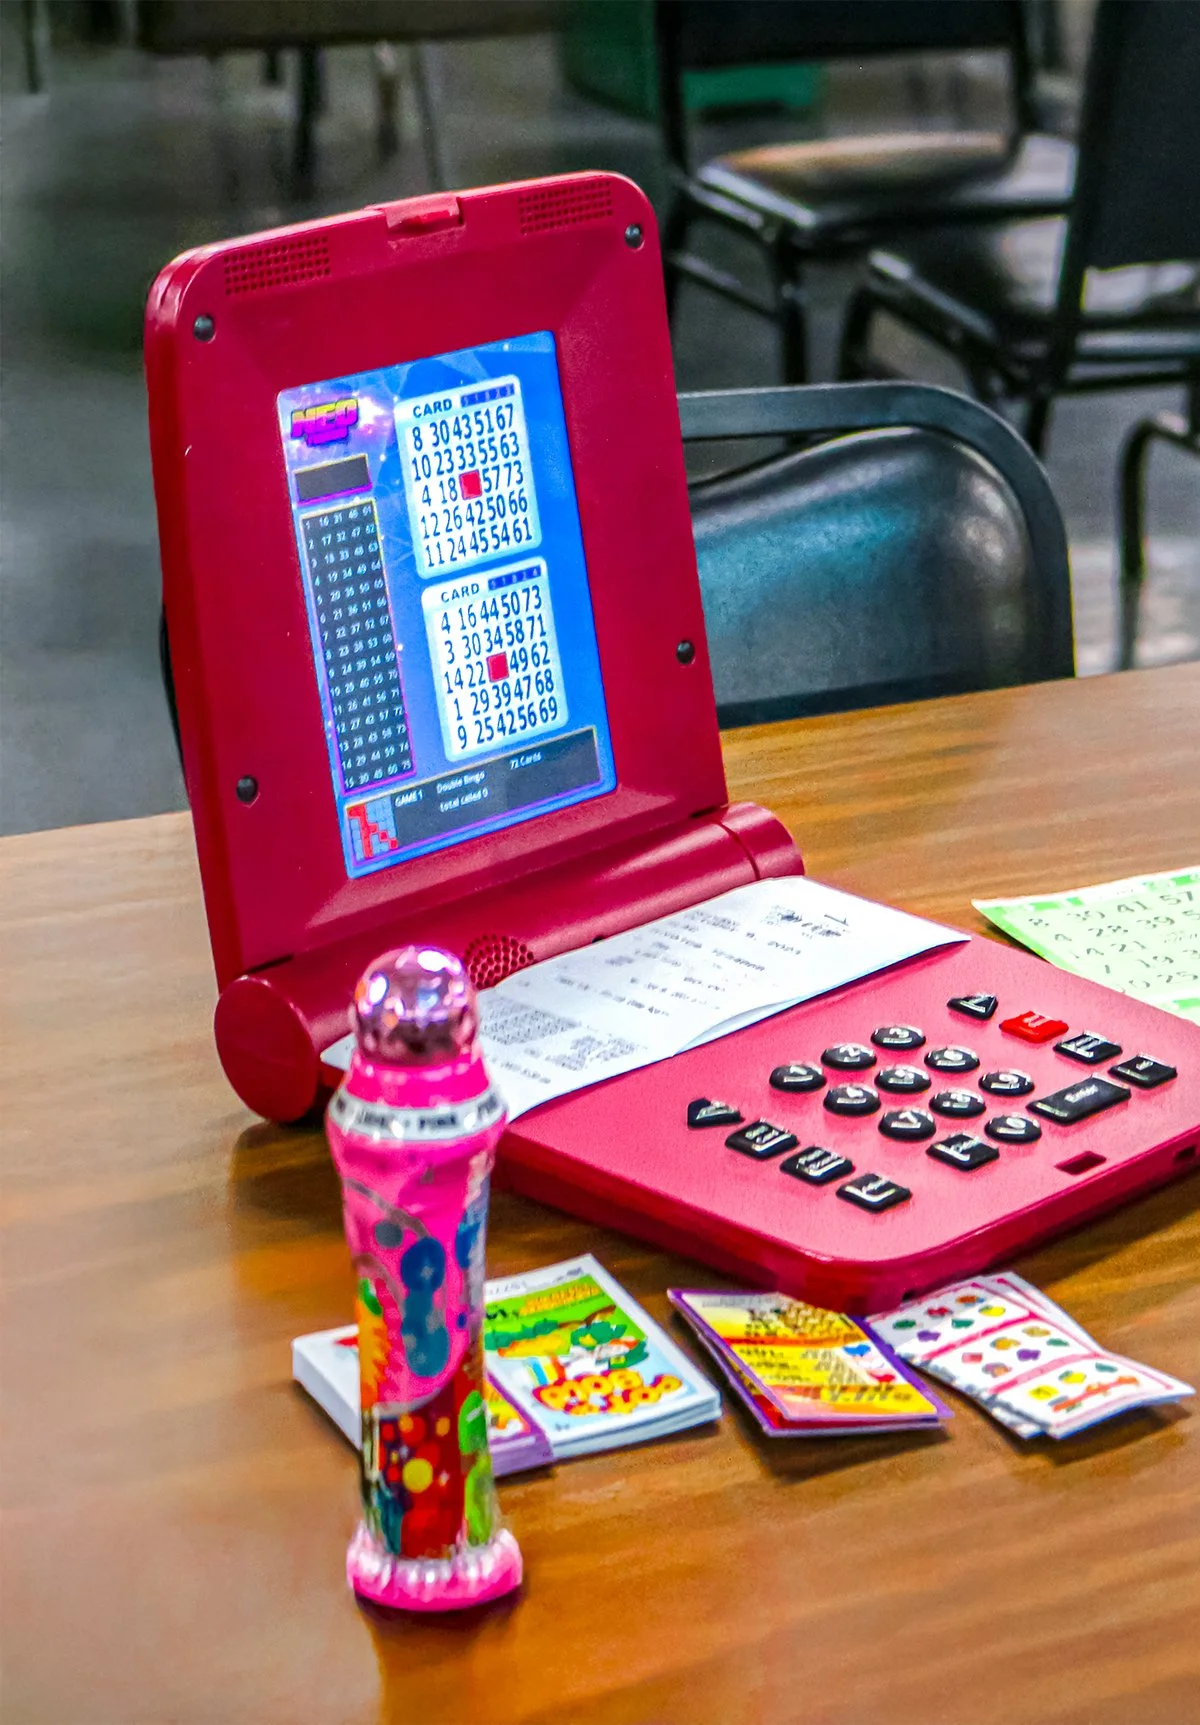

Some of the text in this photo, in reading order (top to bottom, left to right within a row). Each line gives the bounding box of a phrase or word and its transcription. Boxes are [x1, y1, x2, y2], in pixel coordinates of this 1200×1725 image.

[412, 403, 514, 451] 8 30 43 51 67
[413, 399, 453, 418] CARD
[412, 432, 519, 482] 10 23 33 55 63
[441, 583, 479, 603] CARD
[441, 585, 542, 634] 4 16 44 50 73
[445, 614, 546, 664] 3 30 34 58 71
